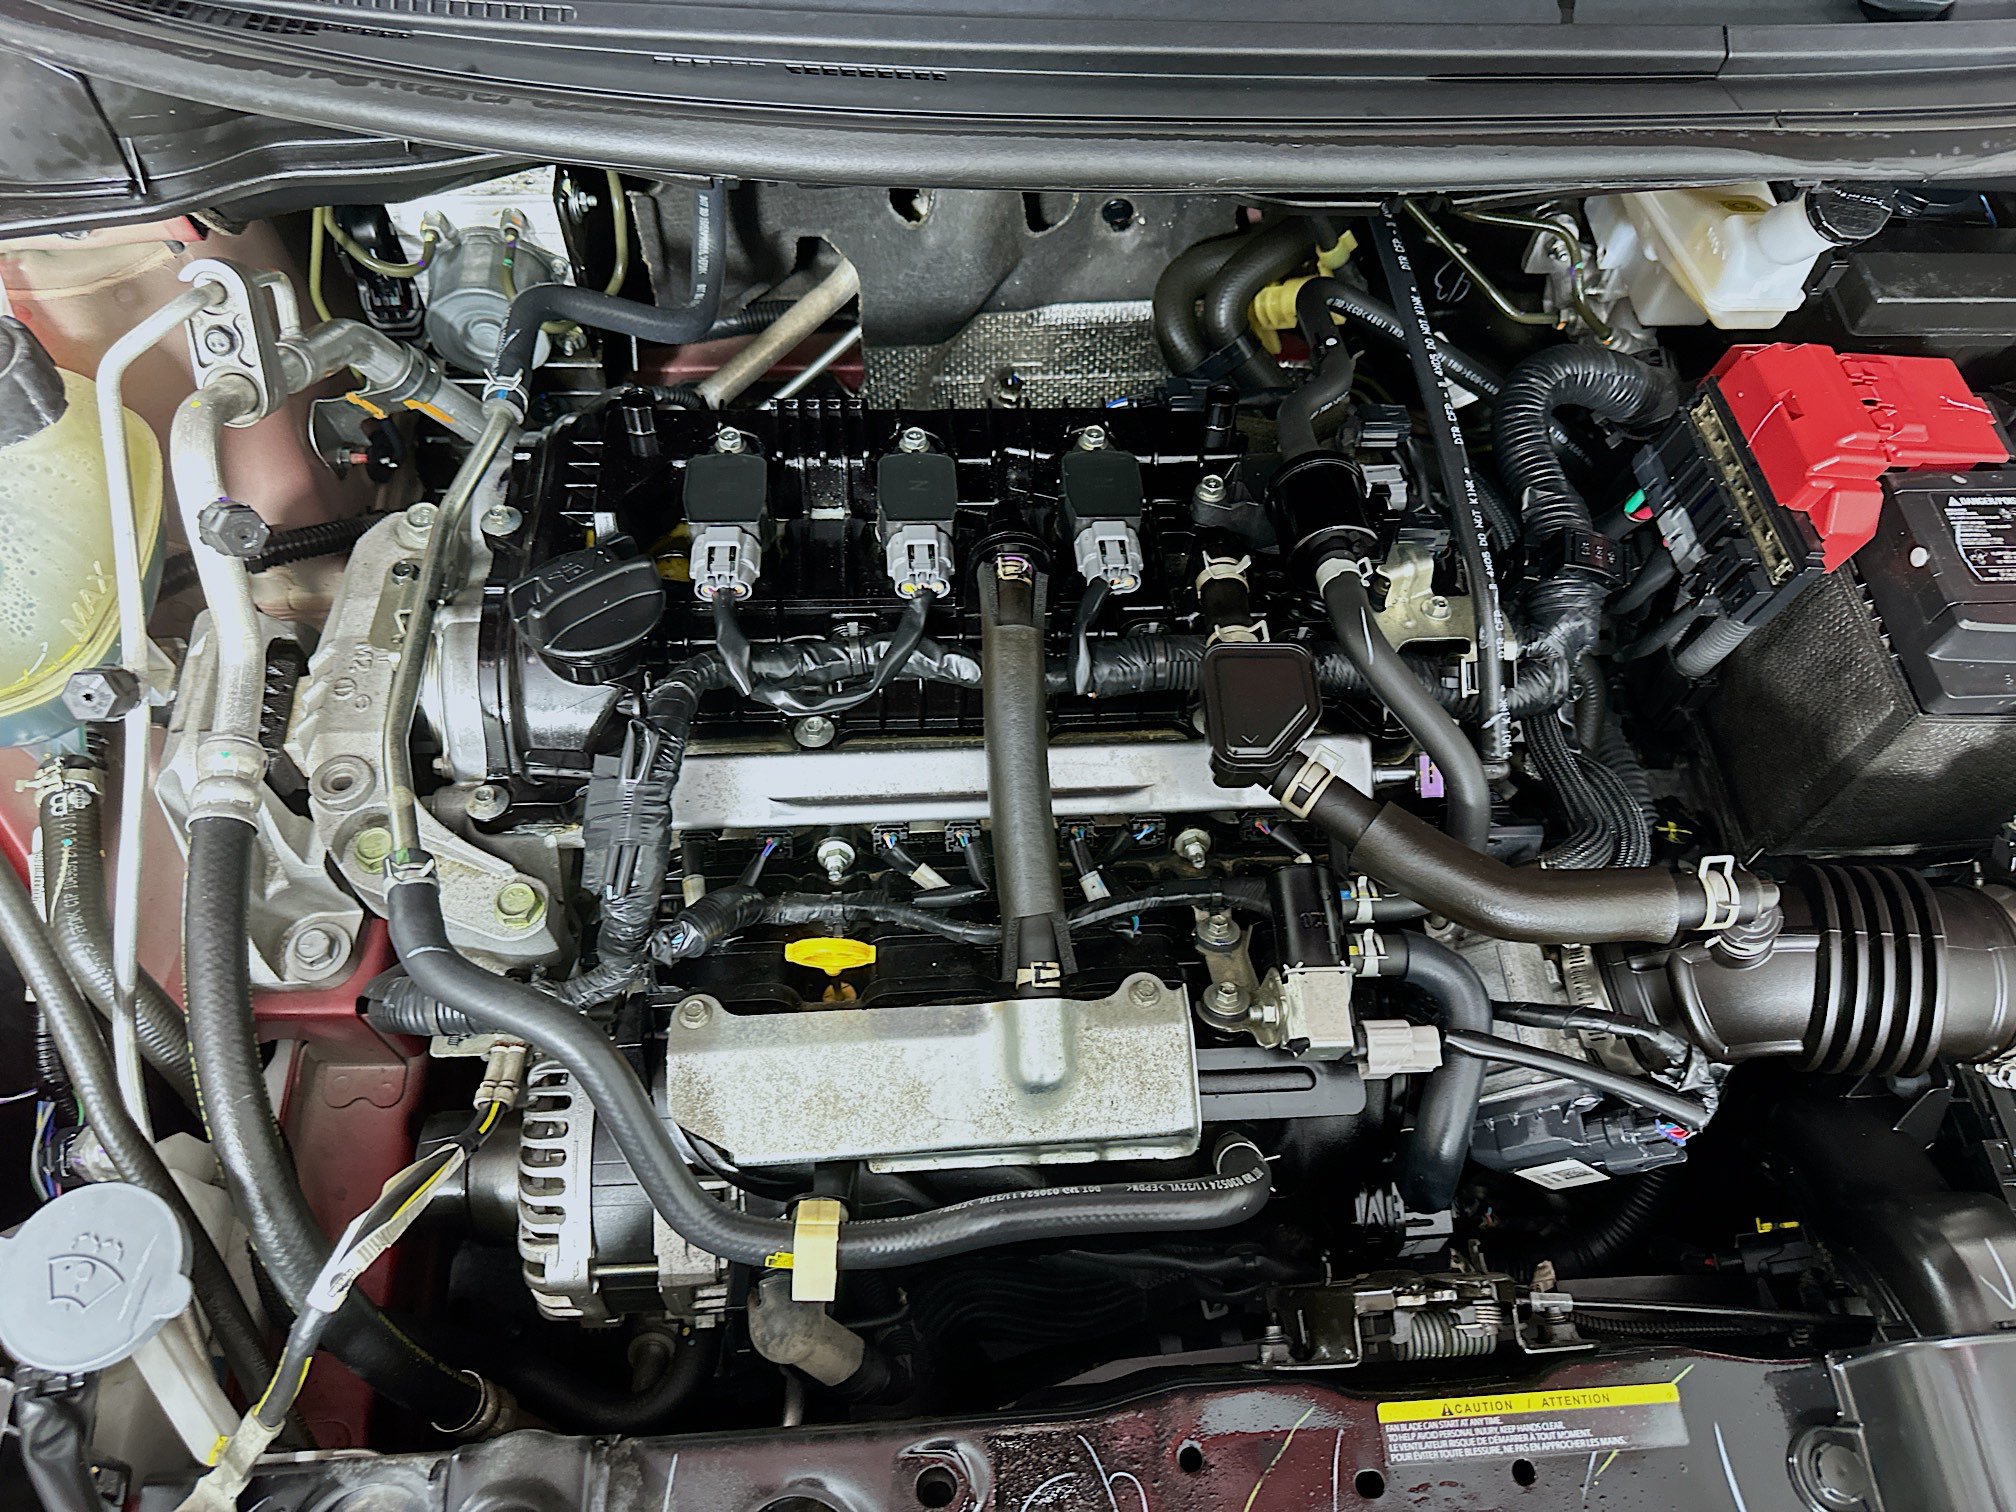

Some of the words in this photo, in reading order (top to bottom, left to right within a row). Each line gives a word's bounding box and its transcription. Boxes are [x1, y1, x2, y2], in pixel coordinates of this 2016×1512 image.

[1411, 296, 1425, 315] KINK
[1418, 319, 1431, 335] NOT
[1424, 338, 1436, 349] DO
[1465, 480, 1478, 504] KINK
[1472, 509, 1484, 528] NOT
[1477, 533, 1488, 546] DO
[1493, 609, 1503, 631] CFP
[1498, 698, 1511, 723] KINK
[1500, 729, 1512, 747] NOT
[1081, 1185, 1101, 1193] DOT
[1125, 1183, 1165, 1191] >EPDM<
[1208, 1176, 1243, 1189] 030524
[1020, 1188, 1059, 1198] 030524
[1454, 1400, 1512, 1413] CAUTION
[1541, 1392, 1610, 1407] ATTENTION
[1385, 1423, 1399, 1432] FAN
[1399, 1421, 1423, 1431] BLADE
[1423, 1420, 1438, 1429] CAN
[1438, 1418, 1459, 1428] START
[1459, 1418, 1468, 1426] AT
[1387, 1434, 1398, 1442] TO
[1398, 1432, 1416, 1441] HELP
[1416, 1430, 1438, 1439] AVOID
[1439, 1428, 1474, 1438] PERSONAL
[1474, 1426, 1499, 1436] INJURY,
[1499, 1424, 1515, 1433] KEEP
[1516, 1422, 1541, 1432] HANDS
[1540, 1420, 1565, 1430] CLEAR.
[1388, 1443, 1399, 1452] LE
[1399, 1439, 1448, 1451] VENTILATEUR
[1448, 1437, 1476, 1447] RISQUE
[1476, 1436, 1487, 1445] DE
[1487, 1433, 1529, 1444] DÉMARRER
[1529, 1431, 1535, 1440] À
[1535, 1431, 1556, 1440] TOUT
[1556, 1428, 1593, 1439] MOMENT.
[1390, 1452, 1413, 1461] POUR
[1440, 1448, 1464, 1457] TOUTE
[1464, 1445, 1503, 1456] BLESSURE,
[1503, 1444, 1514, 1452] NE
[1515, 1443, 1529, 1452] PAS
[1529, 1442, 1541, 1451] EN
[1541, 1438, 1586, 1450] APPROCHER
[1586, 1438, 1599, 1446] LES
[1599, 1435, 1626, 1445] MAINS.
